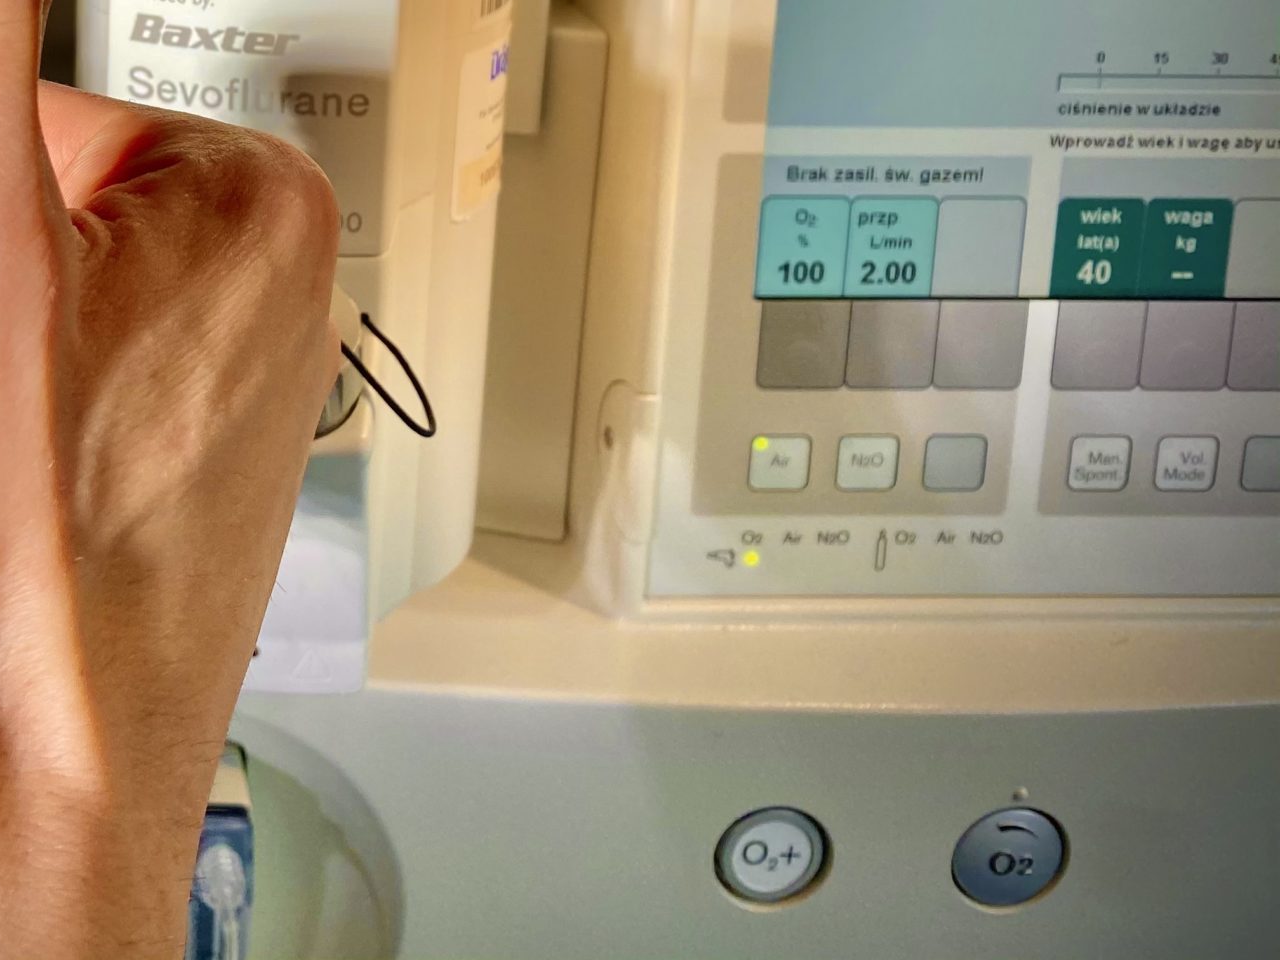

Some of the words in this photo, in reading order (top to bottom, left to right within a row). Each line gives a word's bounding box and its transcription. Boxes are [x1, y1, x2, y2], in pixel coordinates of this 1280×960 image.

[130, 12, 301, 56] Baxter
[1097, 51, 1105, 64] 0
[1154, 52, 1169, 64] 15
[128, 66, 370, 117] Sevoflurane
[1137, 104, 1150, 115] w
[1138, 136, 1175, 149] wiek
[1234, 136, 1262, 152] aby
[786, 165, 827, 183] Brak
[919, 167, 984, 186] gazem!
[858, 210, 899, 229] przp
[1080, 207, 1122, 225] wiek
[1164, 210, 1214, 228] waga
[1175, 235, 1197, 253] kg
[778, 260, 825, 285] 100
[860, 261, 917, 285] 2.00
[1076, 258, 1112, 285] 40
[1163, 467, 1206, 481] Mode
[783, 530, 803, 545] Air
[936, 530, 957, 545] Air
